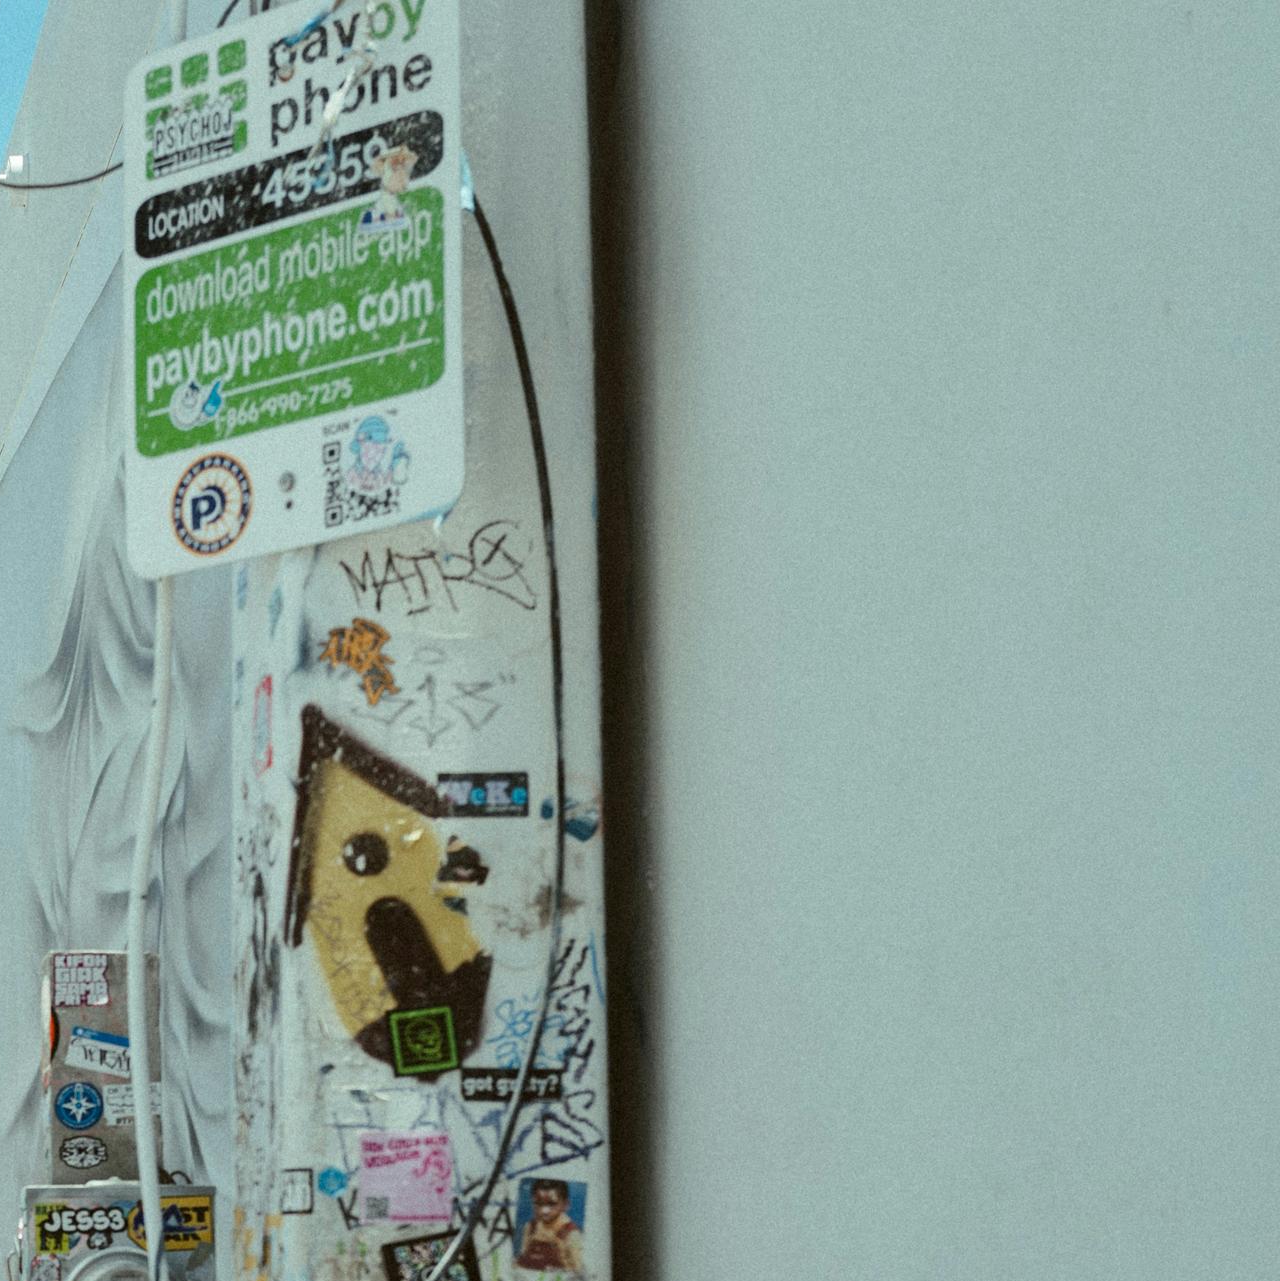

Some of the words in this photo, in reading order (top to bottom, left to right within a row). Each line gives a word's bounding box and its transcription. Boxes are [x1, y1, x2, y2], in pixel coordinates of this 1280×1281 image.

[271, 54, 432, 146] phone
[148, 196, 225, 239] LOCATION
[260, 131, 391, 209] 45359
[146, 245, 271, 324] download
[277, 219, 370, 291] mobile
[377, 208, 433, 267] app
[145, 278, 435, 394] paybyphone.com
[43, 1208, 125, 1232] JESS3
